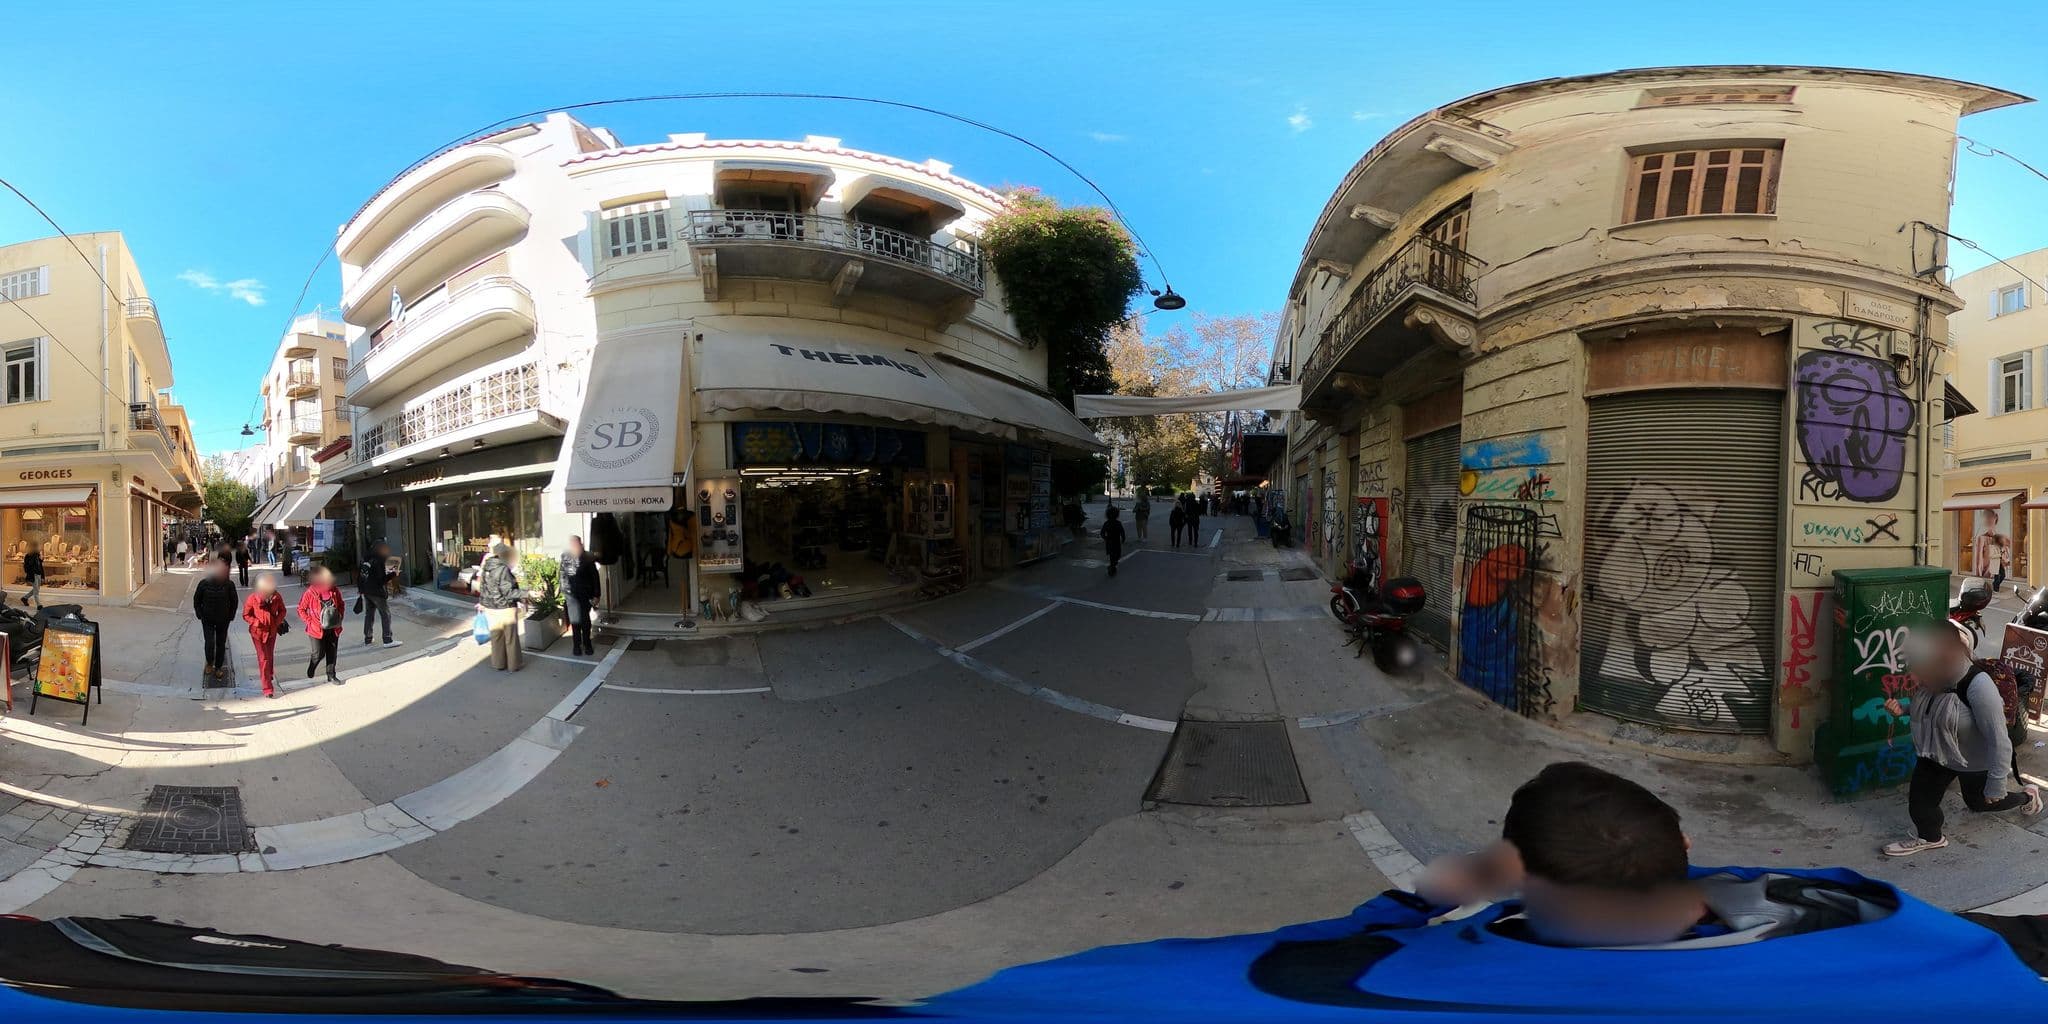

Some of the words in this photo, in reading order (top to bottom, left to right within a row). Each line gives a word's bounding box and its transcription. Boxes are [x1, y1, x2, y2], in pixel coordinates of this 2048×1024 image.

[770, 343, 927, 378] THEMIS
[591, 421, 643, 450] SB
[19, 469, 73, 481] GEORGES
[576, 498, 608, 506] LEATHERS
[641, 497, 665, 505] КОЖА
